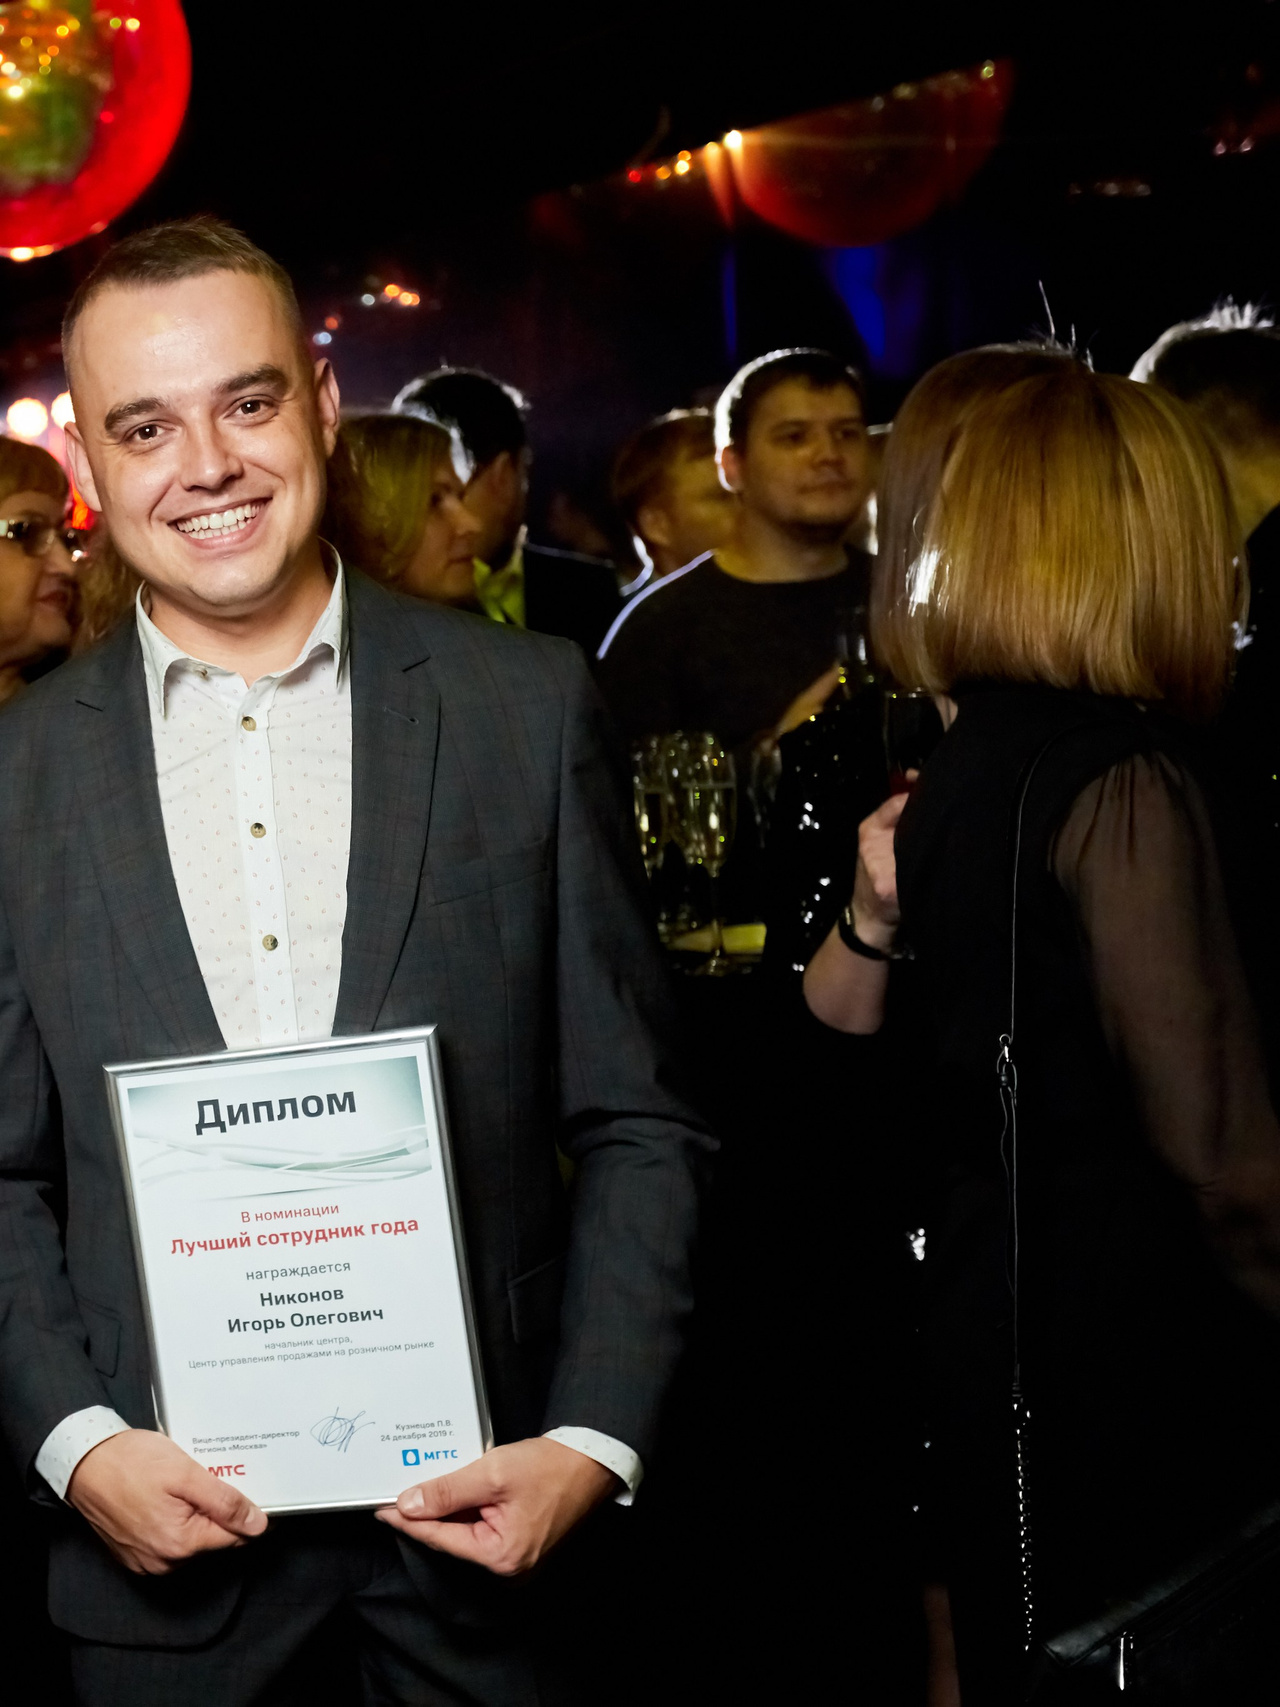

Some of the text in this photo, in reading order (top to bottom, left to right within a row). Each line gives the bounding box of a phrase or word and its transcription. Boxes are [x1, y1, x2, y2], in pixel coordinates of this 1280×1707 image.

[195, 1091, 356, 1135] Диплом
[241, 1205, 339, 1223] В номинации
[171, 1219, 419, 1256] Лучший сотрудник года
[246, 1262, 351, 1282] награждается
[260, 1288, 344, 1307] Никонов
[228, 1307, 384, 1333] Игорь Олегович
[265, 1338, 314, 1350] начальник
[188, 1341, 434, 1369] Центр управления продажами на розничном рынке
[396, 1421, 434, 1431] Кузнецов
[192, 1430, 300, 1445] Вице-президент-директор
[392, 1431, 428, 1443] декабря
[430, 1430, 447, 1438] 2019
[194, 1444, 226, 1454] Региона
[424, 1449, 458, 1461] МГТС
[208, 1465, 245, 1477] МТС
